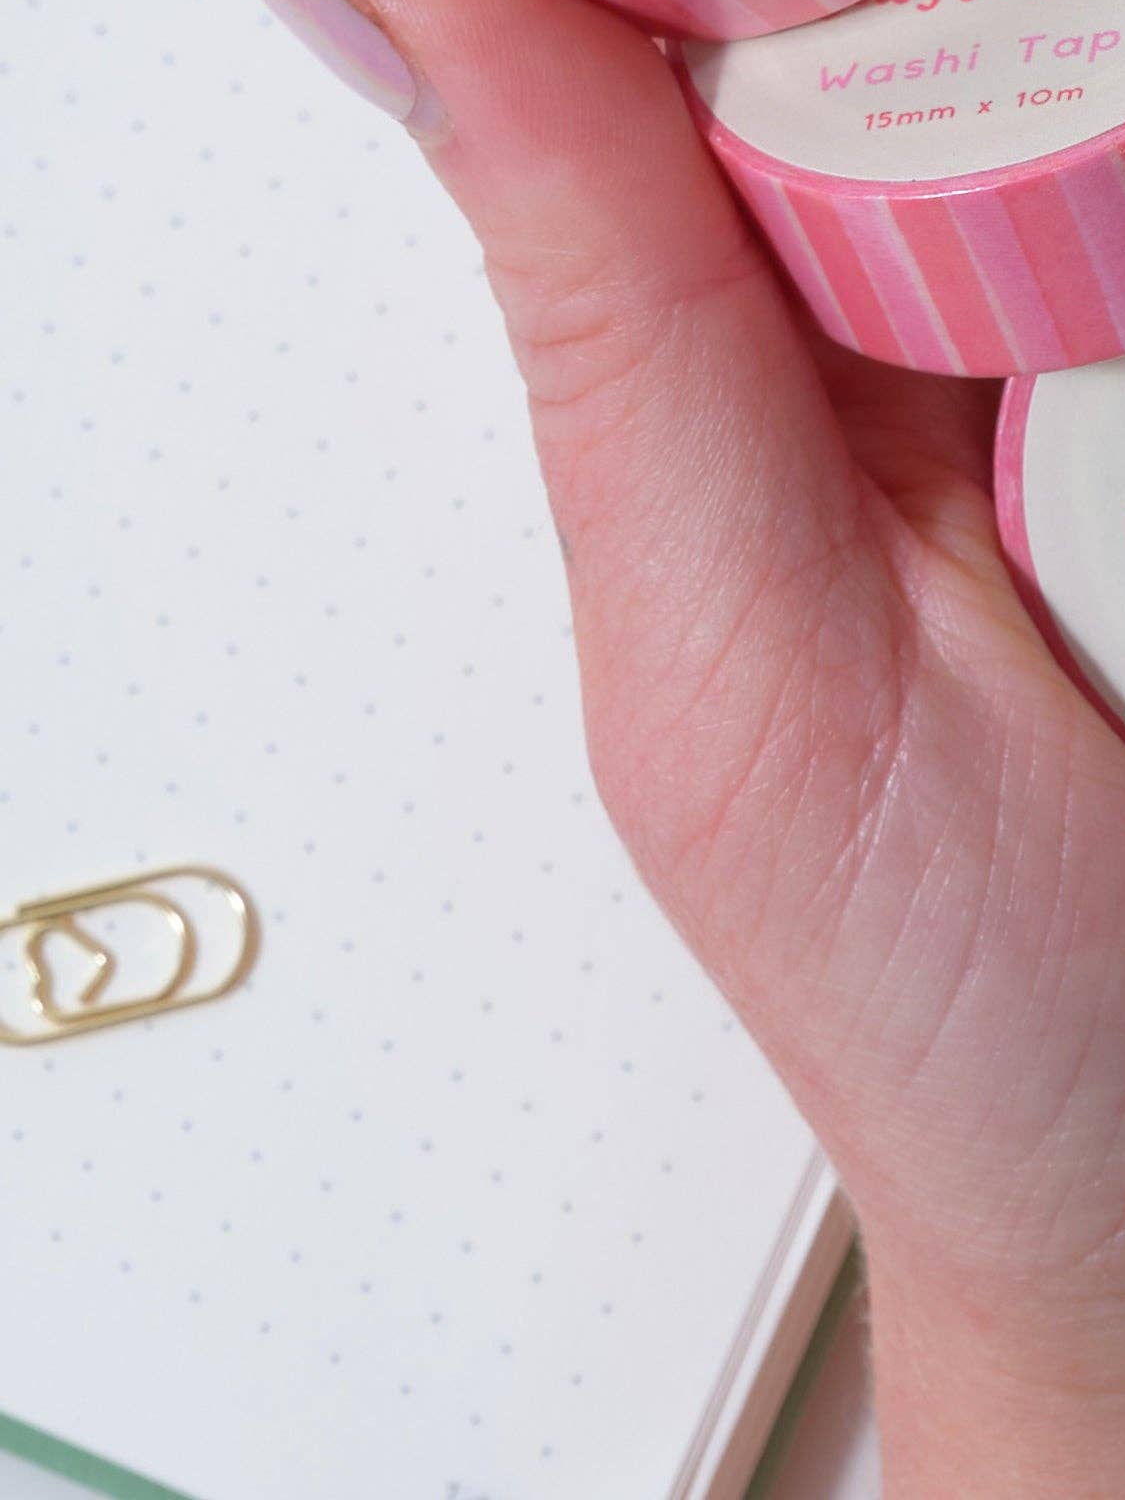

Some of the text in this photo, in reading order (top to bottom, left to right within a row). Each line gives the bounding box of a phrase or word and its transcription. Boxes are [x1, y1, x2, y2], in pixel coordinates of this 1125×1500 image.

[819, 43, 981, 92] Washi
[865, 86, 1085, 131] 15mm x 10m
